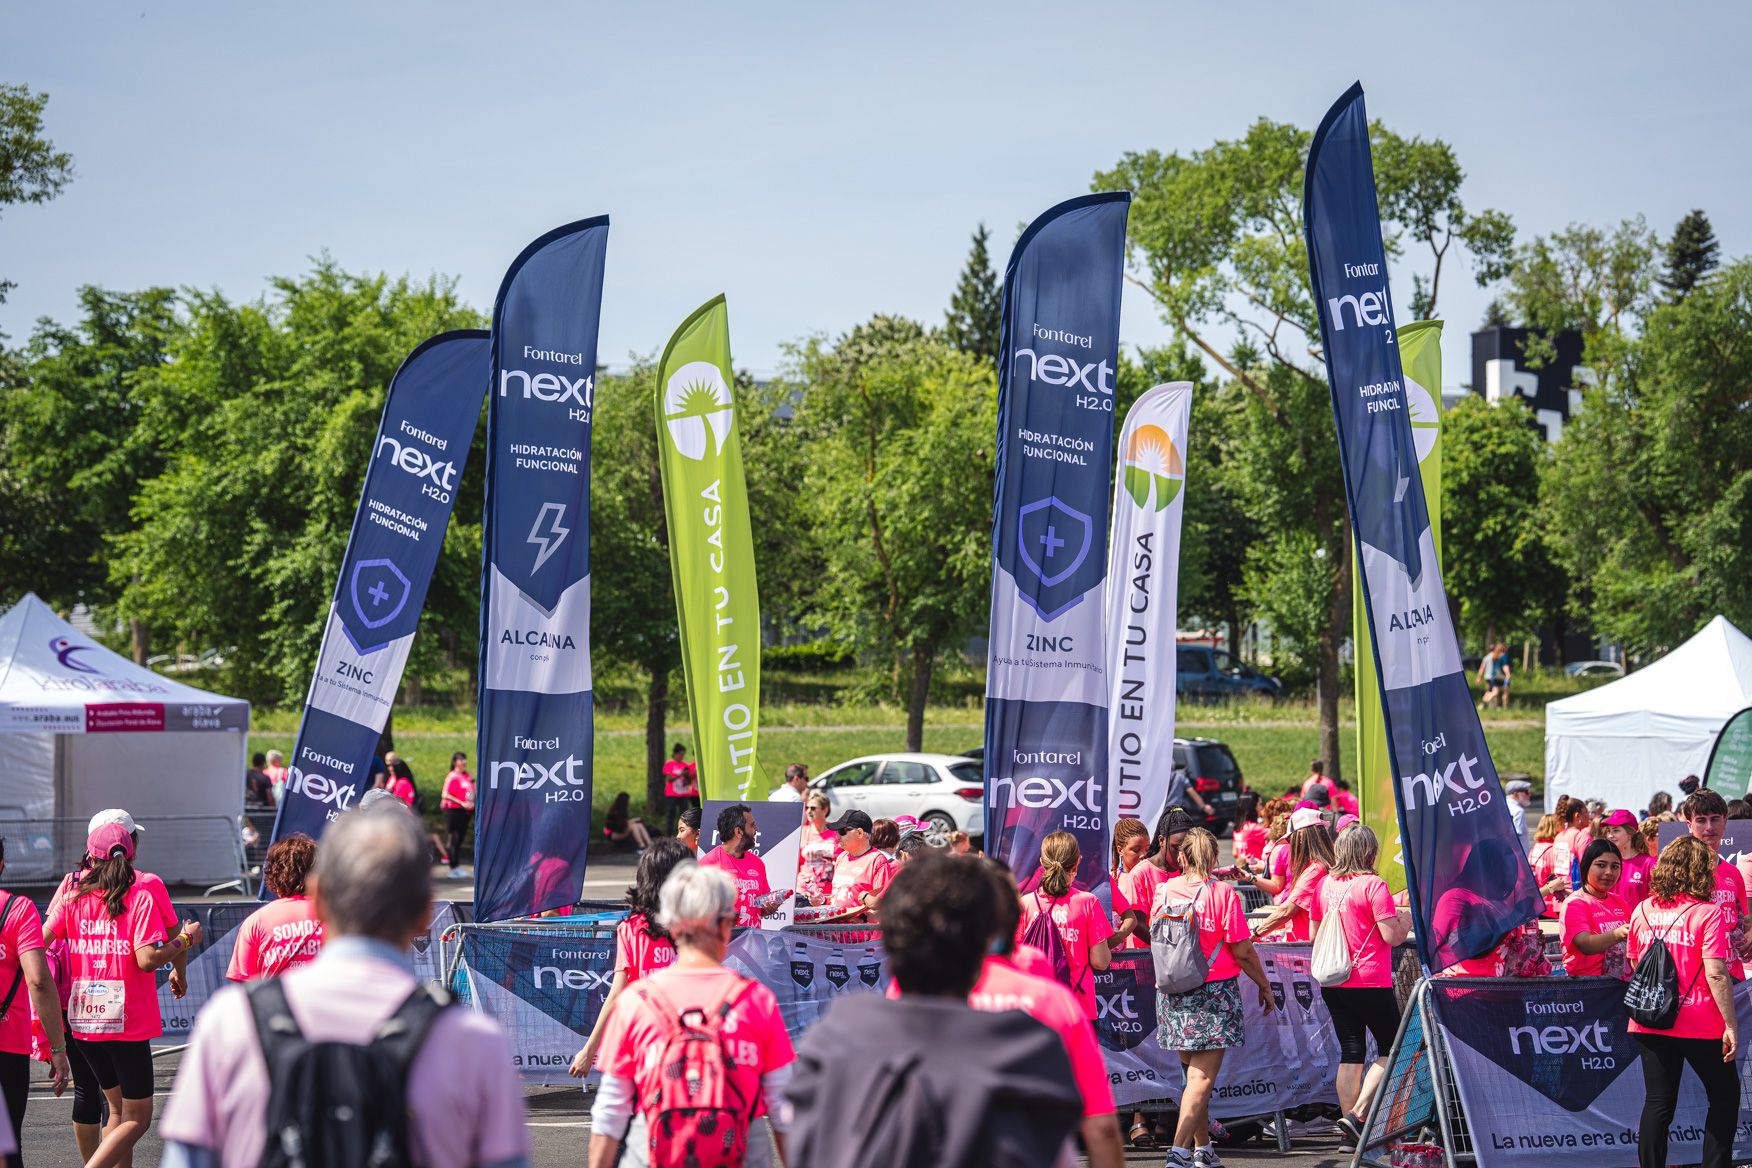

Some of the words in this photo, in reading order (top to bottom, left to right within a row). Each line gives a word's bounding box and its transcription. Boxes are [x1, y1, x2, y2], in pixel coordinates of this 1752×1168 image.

[1033, 323, 1092, 348] Fontarel
[524, 345, 582, 365] Fontarel
[1013, 346, 1114, 395] next
[500, 369, 594, 408] next
[1076, 394, 1112, 412] H2.0
[400, 419, 448, 451] Fontarel
[1018, 428, 1094, 451] HIDRATACIÓN
[376, 434, 457, 491] next
[510, 444, 582, 461] HIDRATACIÓN
[1023, 444, 1087, 466] FUNCIONAL
[516, 458, 578, 474] FUNCIONAL
[421, 483, 450, 504] H2.0
[368, 498, 428, 531] HIDRATACIÓN
[369, 512, 420, 541] FUNCIONAL
[700, 479, 724, 574] CASA
[1130, 531, 1154, 614] CASA
[714, 586, 734, 635] TU
[1026, 634, 1074, 653] ZINC
[1123, 624, 1147, 667] TU
[336, 660, 374, 685] ZINC
[717, 644, 745, 692] EN
[1029, 658, 1062, 669] Sistema
[337, 679, 362, 696] Sistema
[1120, 679, 1144, 721] EN
[301, 746, 355, 775] Fontarel
[490, 753, 584, 790] next
[1119, 732, 1142, 819] UTIO
[286, 764, 357, 812] next
[545, 789, 584, 803] H2.0
[989, 775, 1102, 813] next
[1447, 790, 1492, 817] H2.0
[1063, 814, 1101, 831] H2.0
[79, 919, 118, 936] SOMOS
[272, 919, 323, 943] SOMOS
[552, 948, 610, 960] Fontarel
[533, 965, 615, 990] nex
[86, 1005, 106, 1013] 016
[1525, 1001, 1584, 1014] Fontarel
[172, 1015, 189, 1029] de
[1111, 1022, 1143, 1033] H2.0
[1508, 1018, 1613, 1055] next
[527, 1055, 575, 1066] nuev
[1581, 1056, 1616, 1070] H2.0
[1126, 1068, 1156, 1082] era
[1492, 1132, 1516, 1150] La
[1519, 1132, 1578, 1149] nueva
[1586, 1131, 1617, 1147] era
